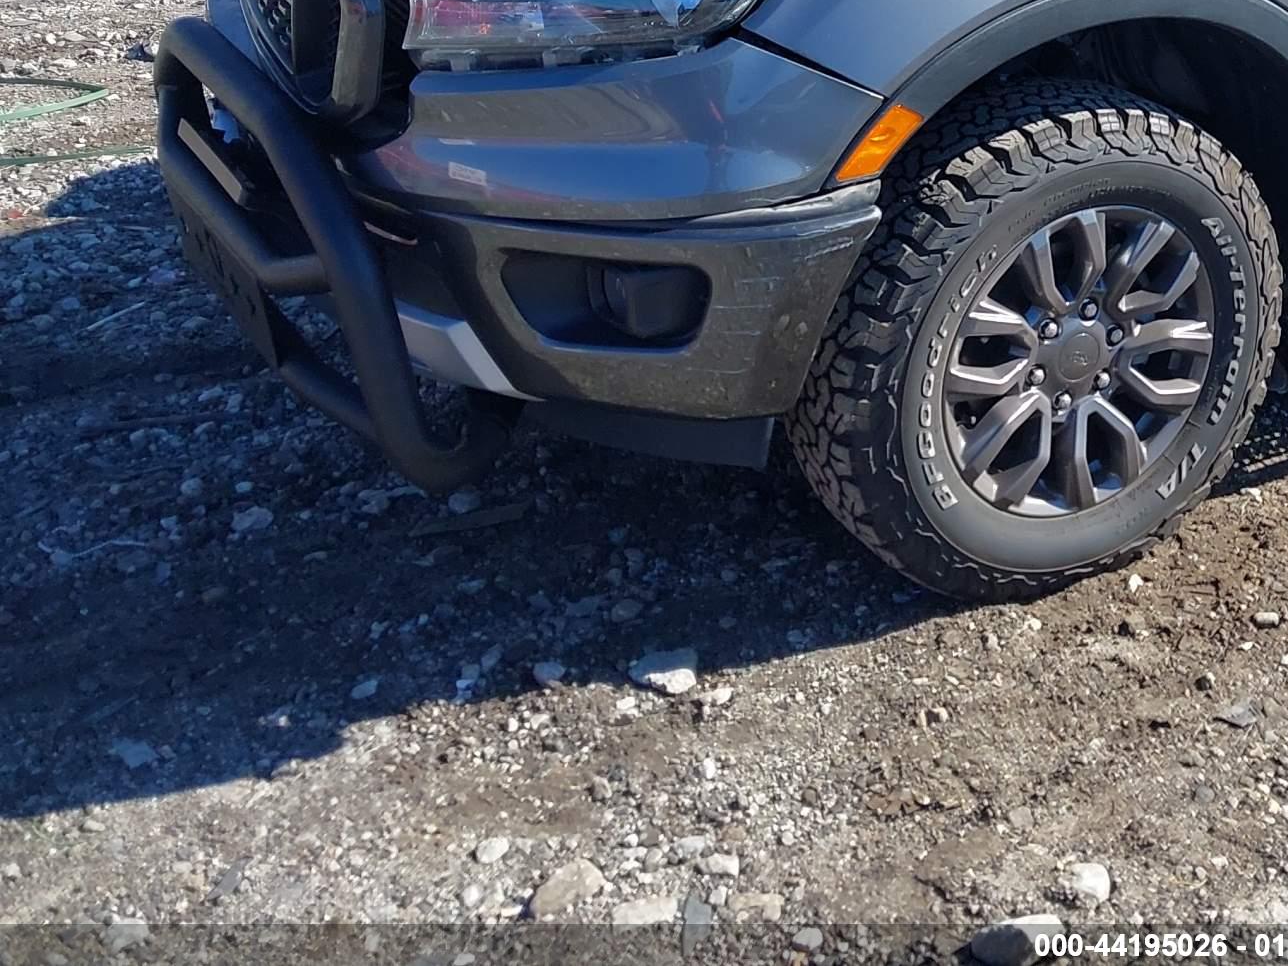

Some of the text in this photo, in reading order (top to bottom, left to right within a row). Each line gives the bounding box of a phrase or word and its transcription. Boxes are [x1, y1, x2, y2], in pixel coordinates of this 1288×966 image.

[916, 243, 997, 511] BFGoodrich
[1200, 216, 1248, 427] All-Terrain
[1154, 442, 1208, 500] T/A
